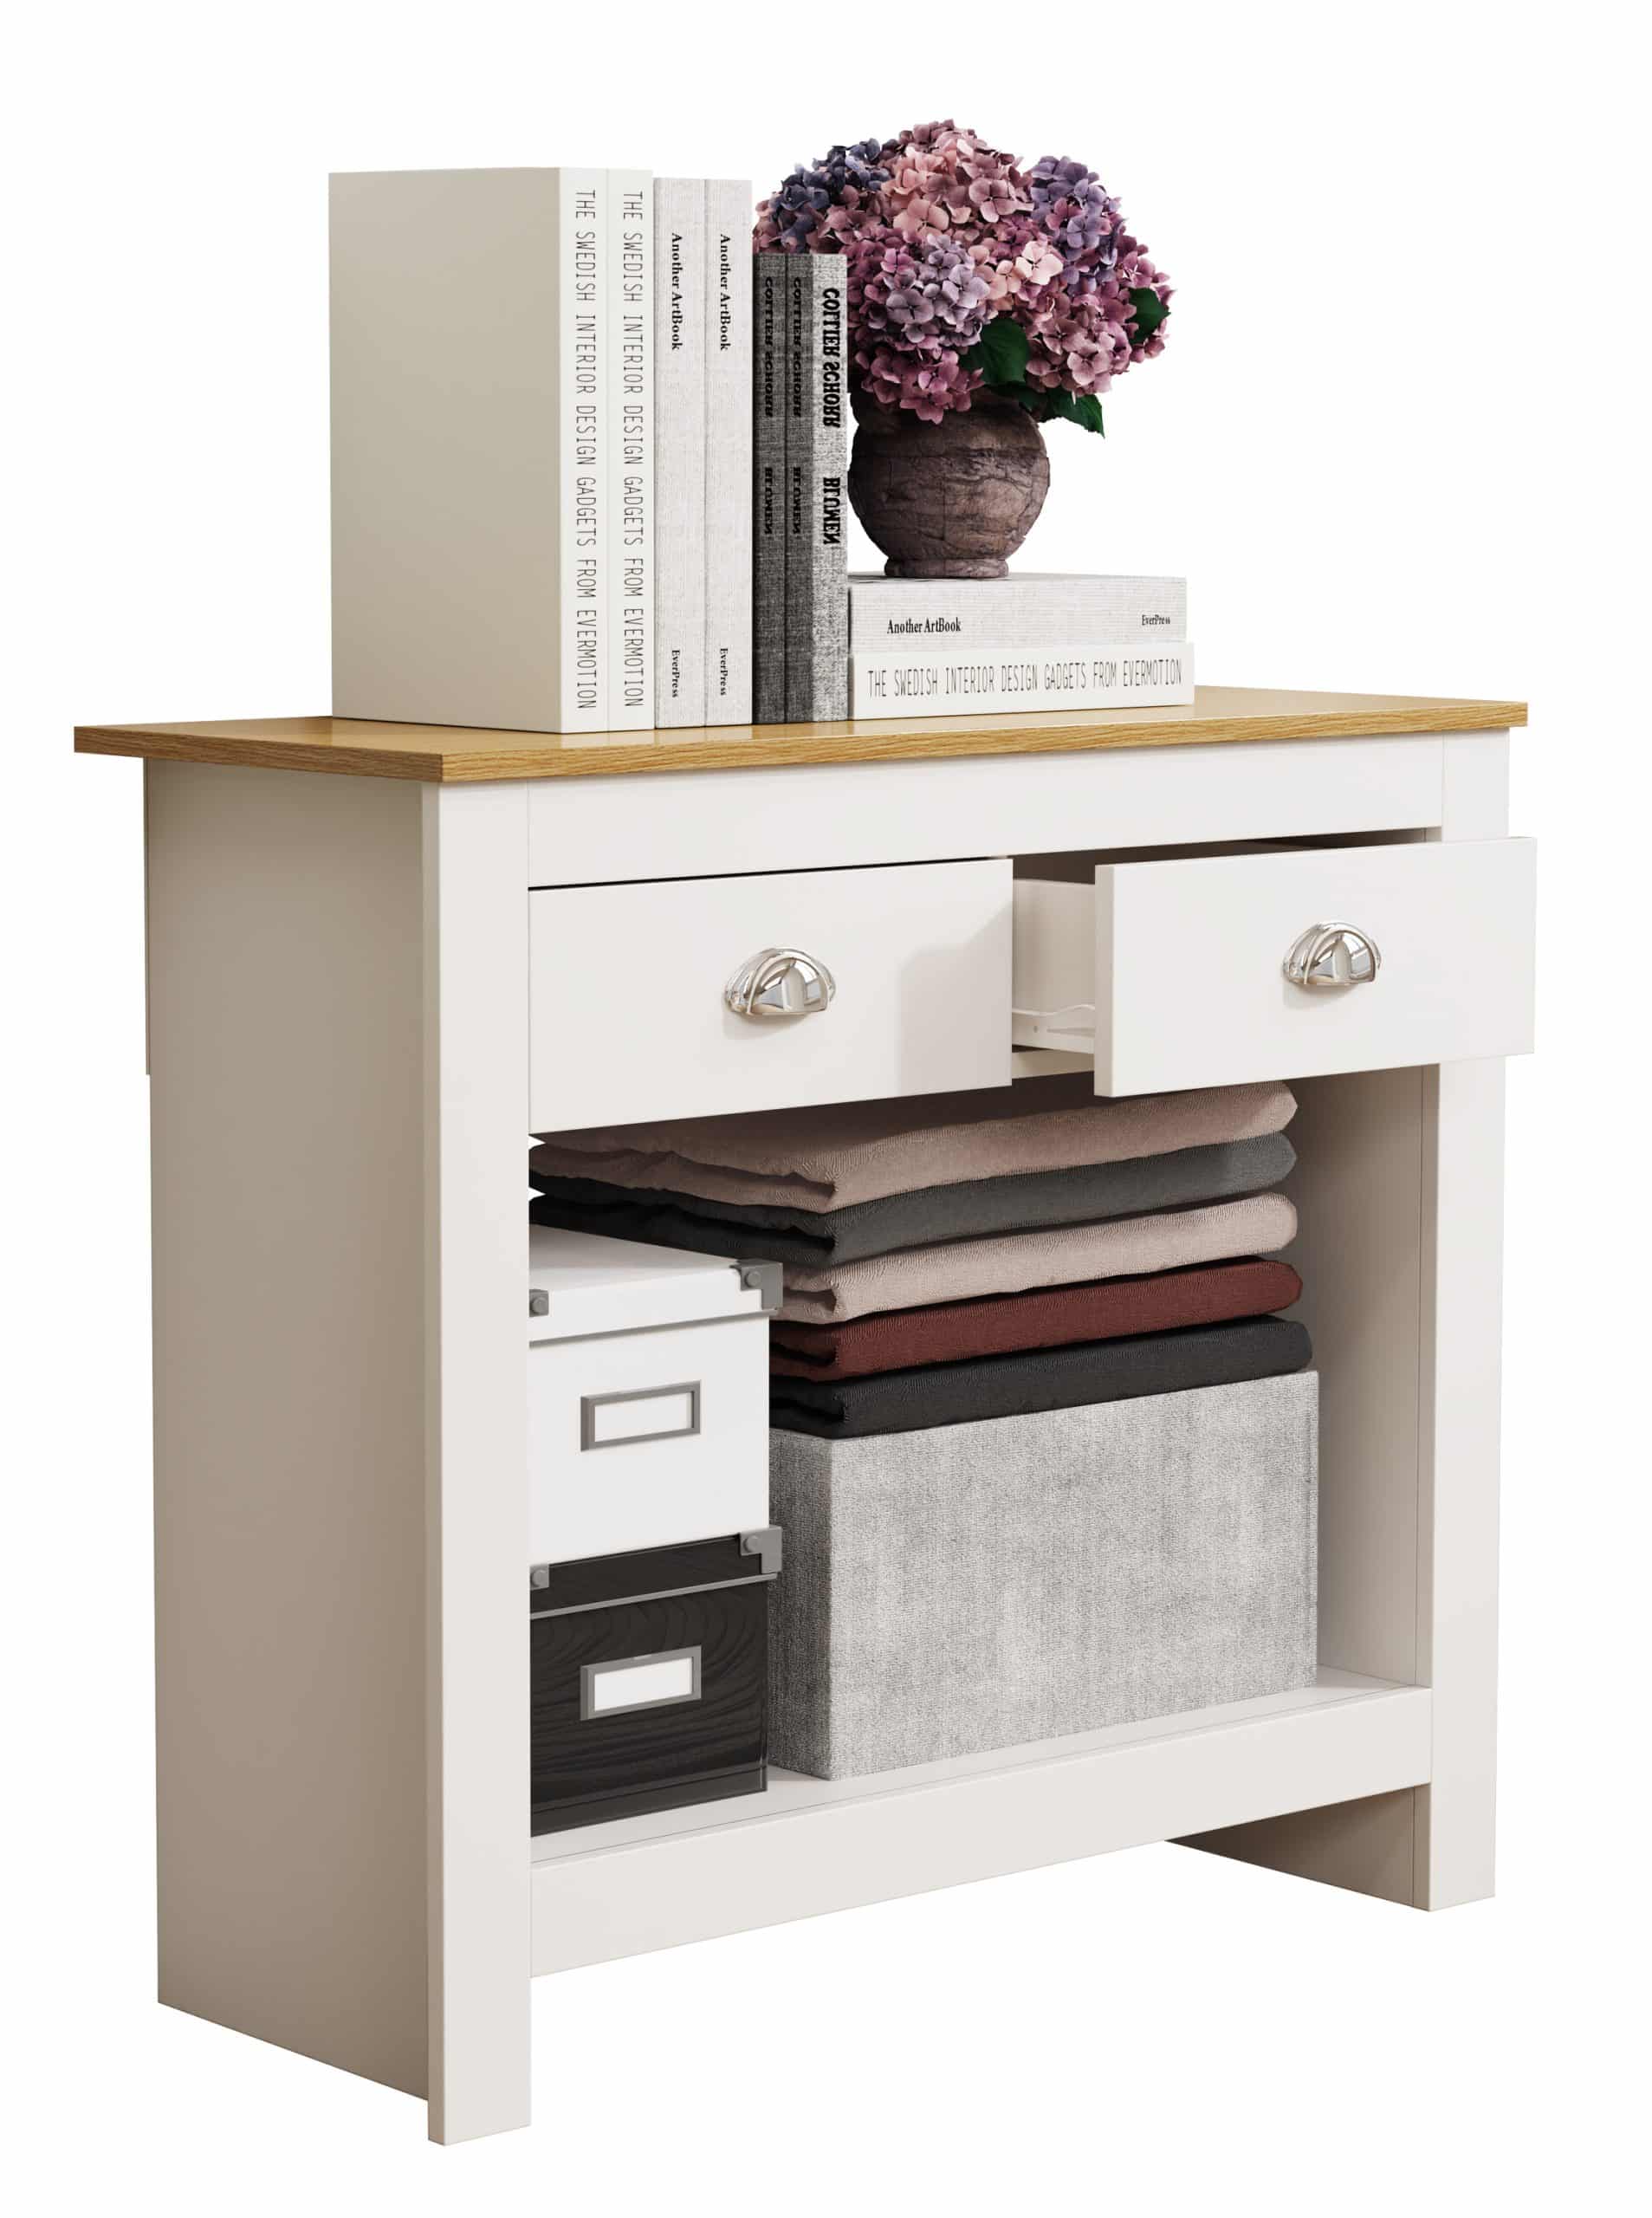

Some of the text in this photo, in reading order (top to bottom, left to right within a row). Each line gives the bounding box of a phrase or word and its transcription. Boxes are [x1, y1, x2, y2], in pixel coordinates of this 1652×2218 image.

[671, 232, 683, 351] Another ArtBook
[720, 233, 731, 352] Another ArtBook
[575, 189, 597, 709] THE SWEDISH INTERIOR DESIGN GADGETS FROM EVERMOTION
[623, 189, 645, 709] THE SWEDISH INTERIOR DESIGN GADGETS FROM EVERMOTION
[887, 616, 962, 634] Another ArtBook
[1141, 613, 1171, 626] EverPress
[671, 649, 680, 698] EverPress
[720, 647, 729, 696] EverPress
[867, 658, 1182, 697] THE SWEDISH INTERIOR DESIGN GADGETS FROM EVERMOTION
